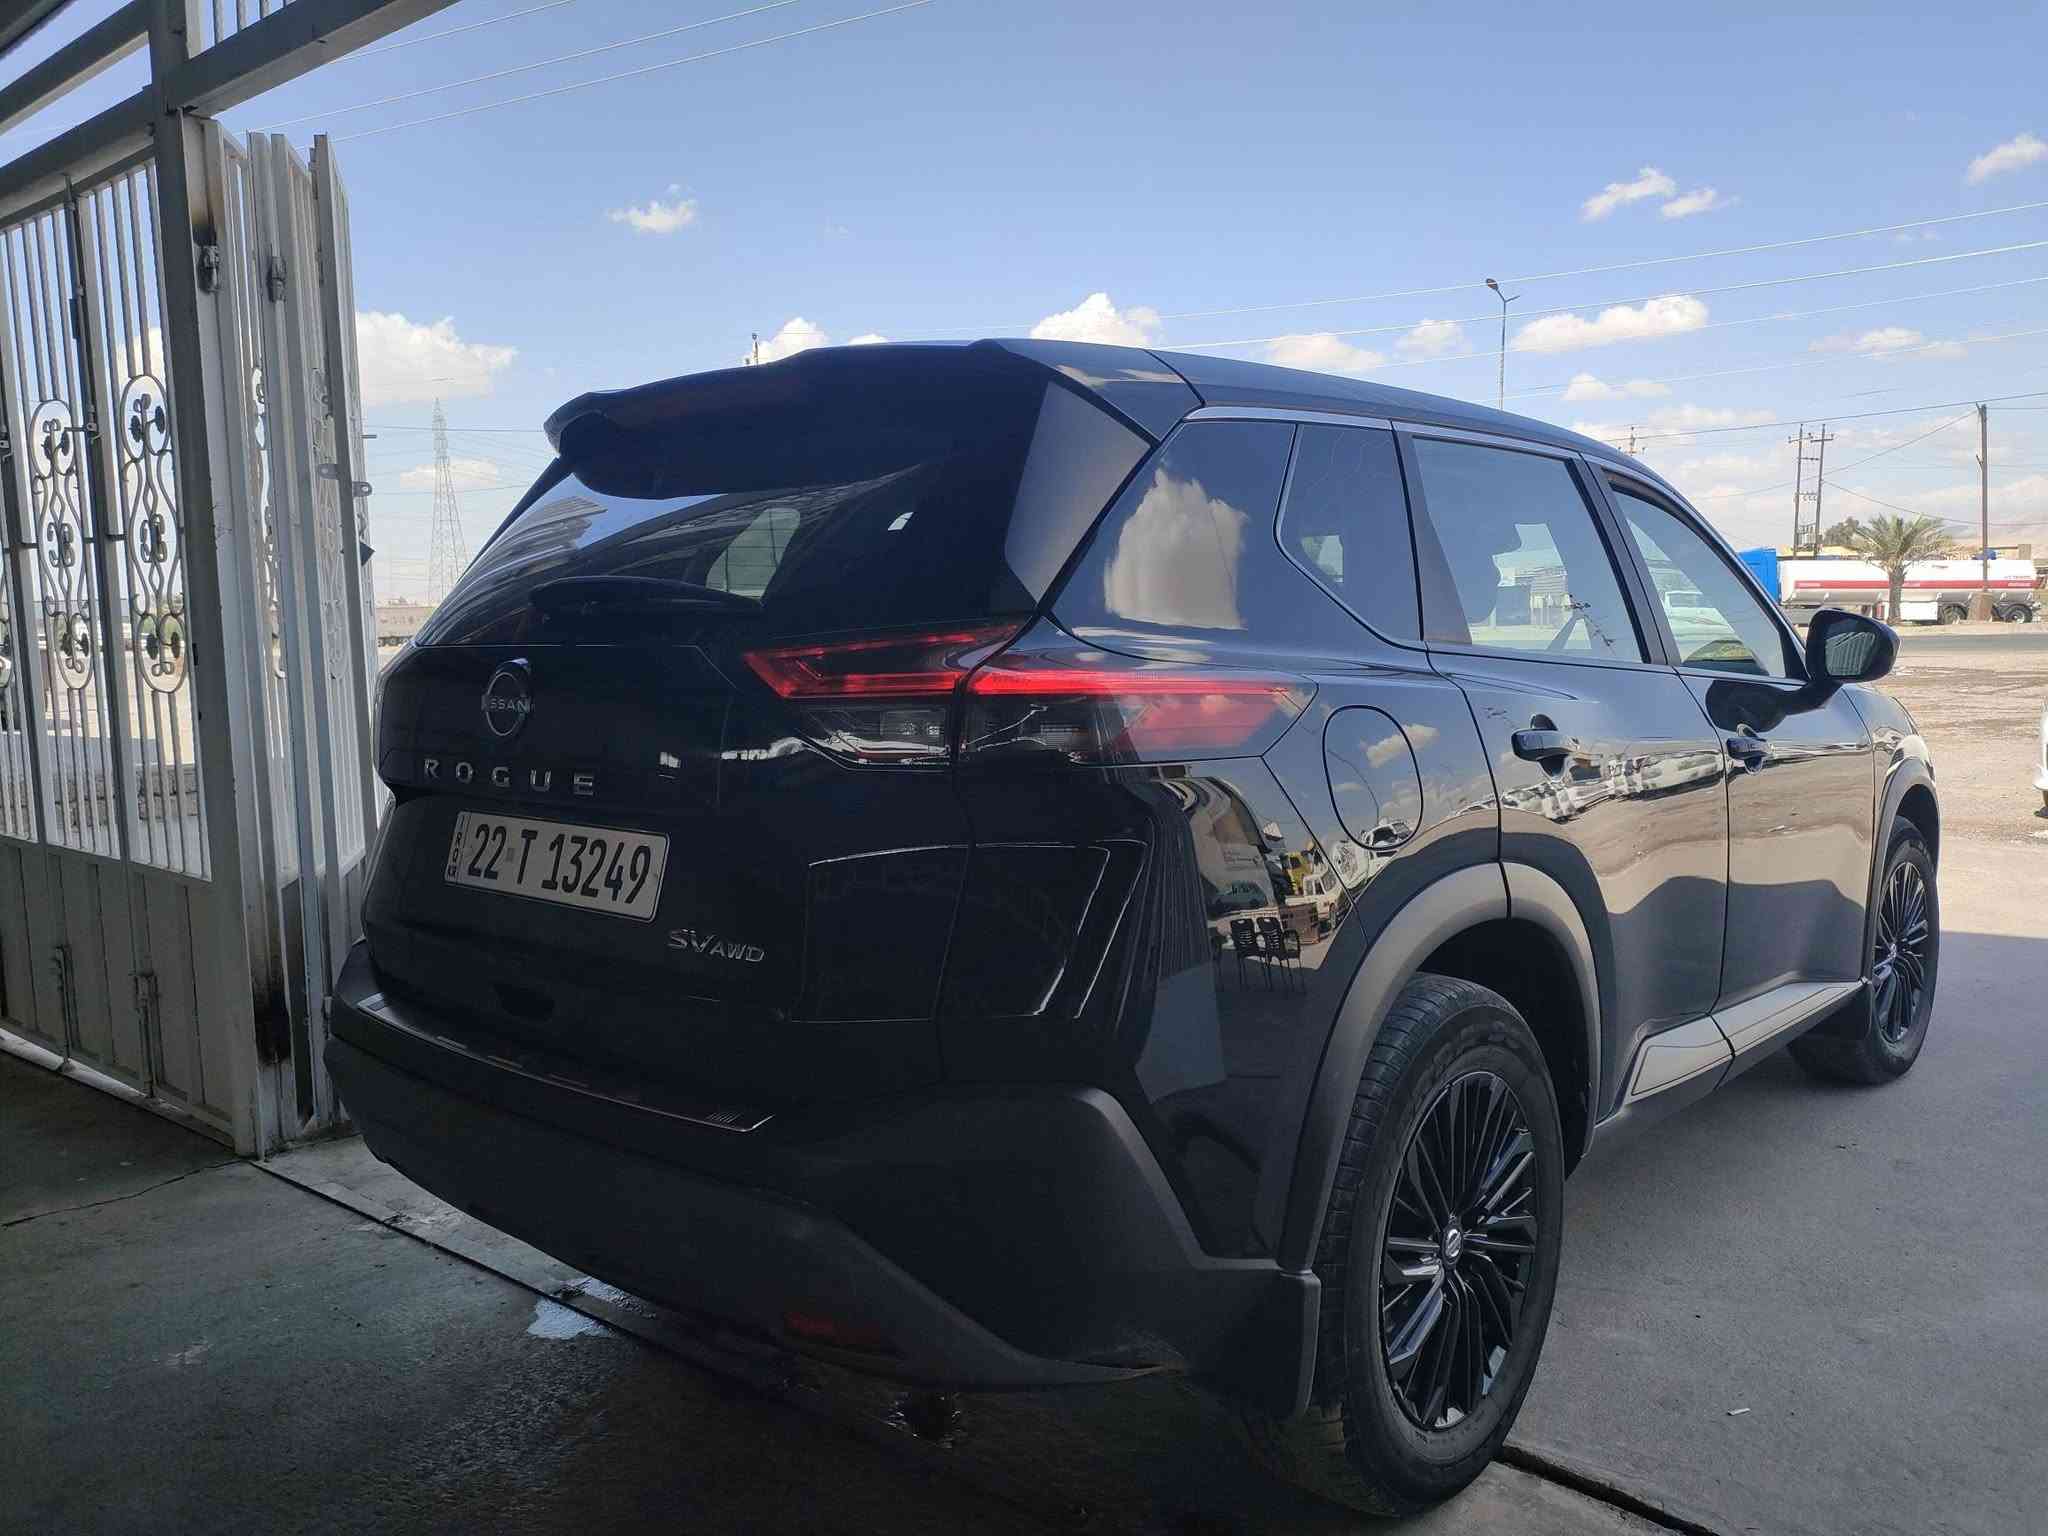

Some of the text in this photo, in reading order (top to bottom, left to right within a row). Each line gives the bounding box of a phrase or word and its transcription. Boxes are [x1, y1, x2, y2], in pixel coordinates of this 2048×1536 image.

[424, 759, 596, 796] ROGUE
[467, 823, 653, 904] 22 T 13249
[709, 941, 765, 963] AWD
